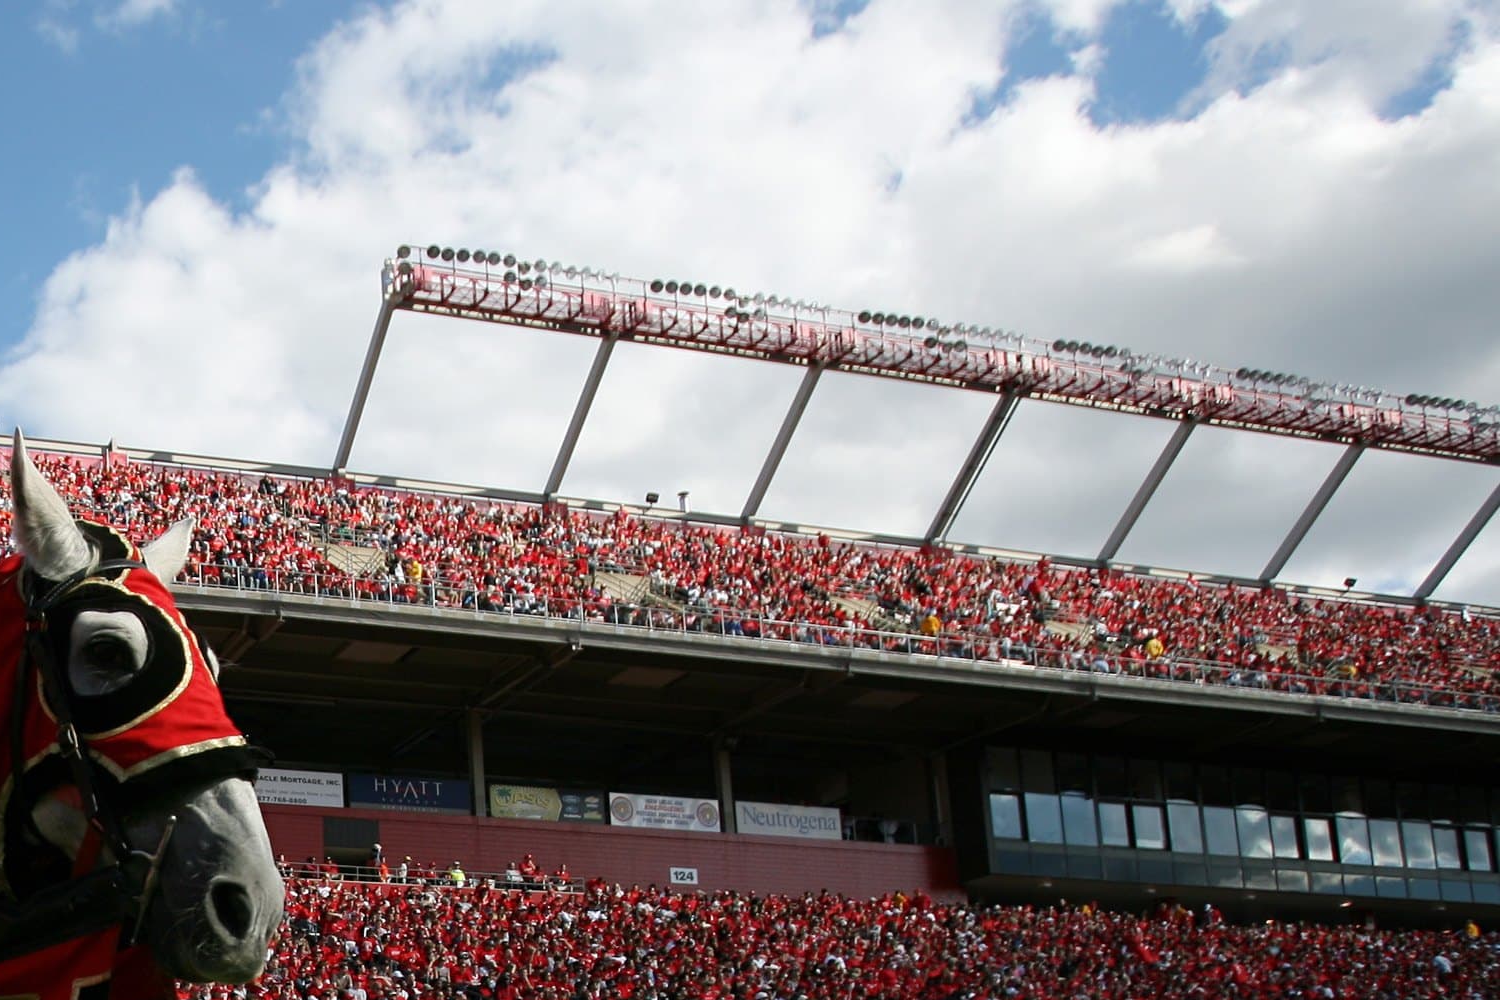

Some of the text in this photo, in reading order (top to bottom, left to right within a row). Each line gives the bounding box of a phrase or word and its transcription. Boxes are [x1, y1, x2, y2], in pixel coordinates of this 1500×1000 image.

[374, 778, 443, 799] HYATT
[742, 806, 838, 834] Neutrogena
[673, 871, 695, 882] 124
